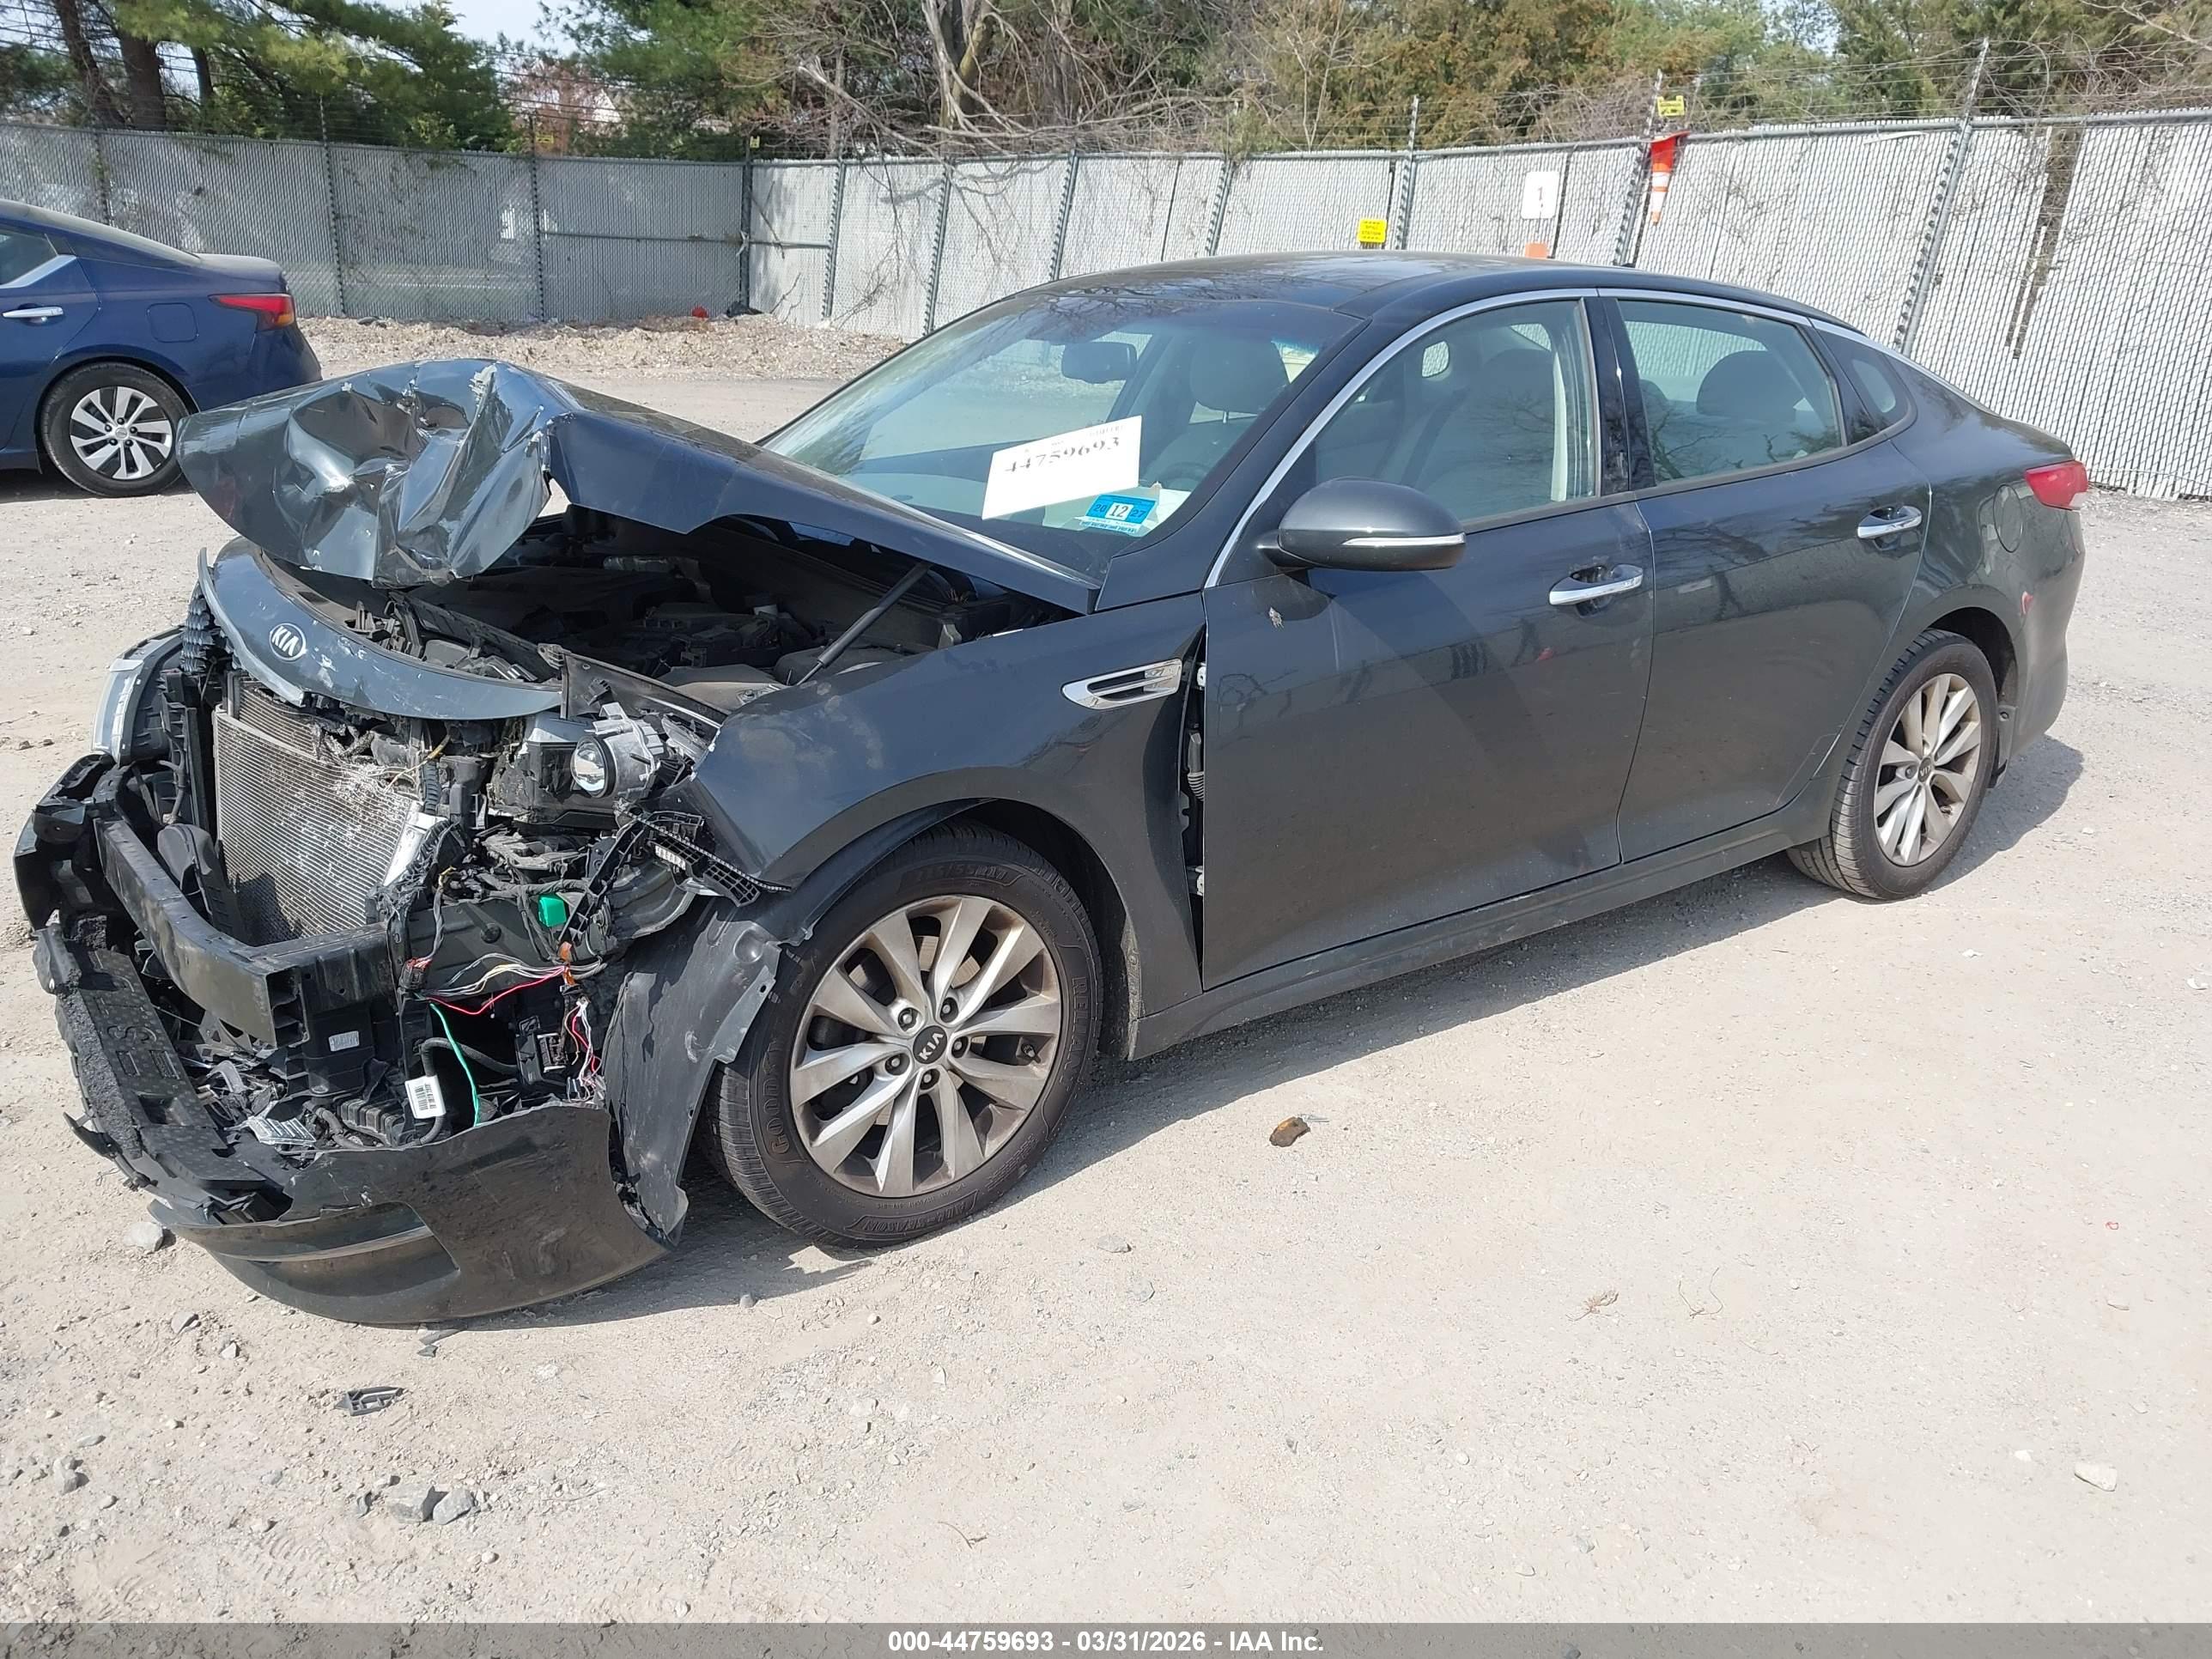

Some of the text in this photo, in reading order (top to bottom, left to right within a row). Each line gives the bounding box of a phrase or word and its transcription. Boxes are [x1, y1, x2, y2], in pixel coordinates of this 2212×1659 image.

[1005, 436, 1120, 472] 44759693
[1093, 503, 1147, 518] 20 12 27
[271, 625, 300, 657] KIA
[919, 1032, 944, 1060] KIA
